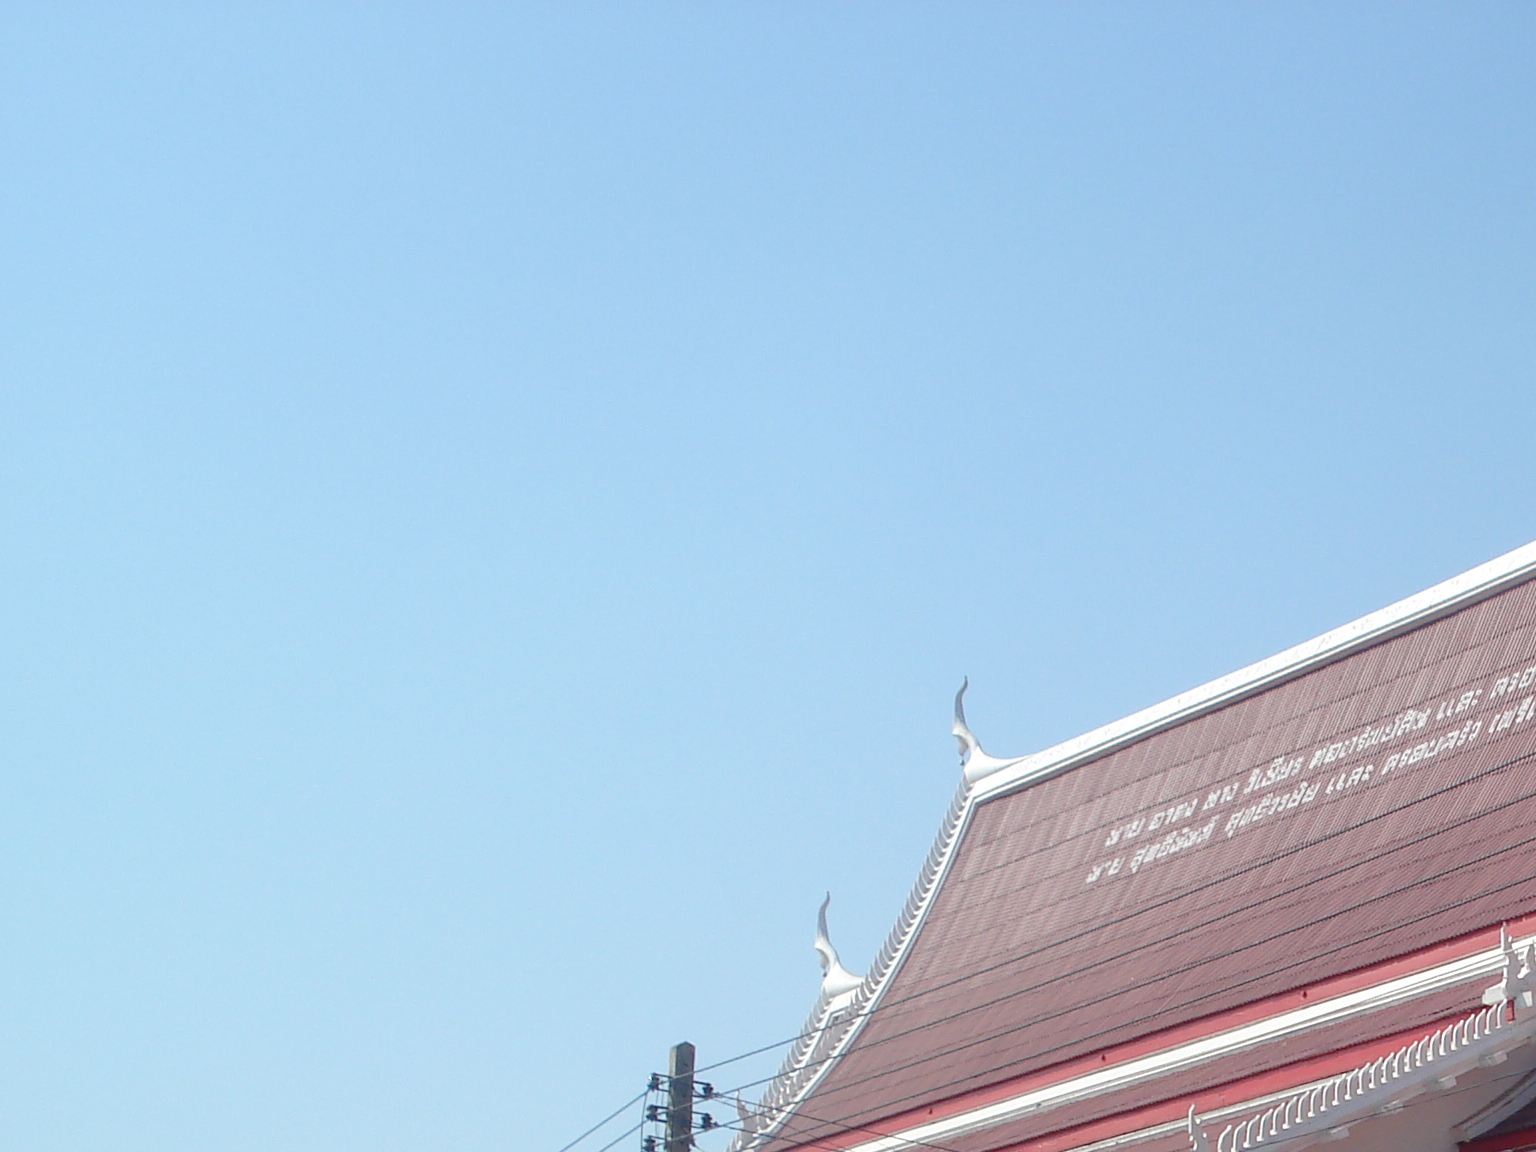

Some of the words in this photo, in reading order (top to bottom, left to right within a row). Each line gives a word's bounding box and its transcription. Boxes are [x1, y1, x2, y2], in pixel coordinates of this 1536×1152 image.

[1436, 689, 1483, 720] และ
[1325, 764, 1374, 795] และ
[1382, 720, 1483, 776] ครอบครัว
